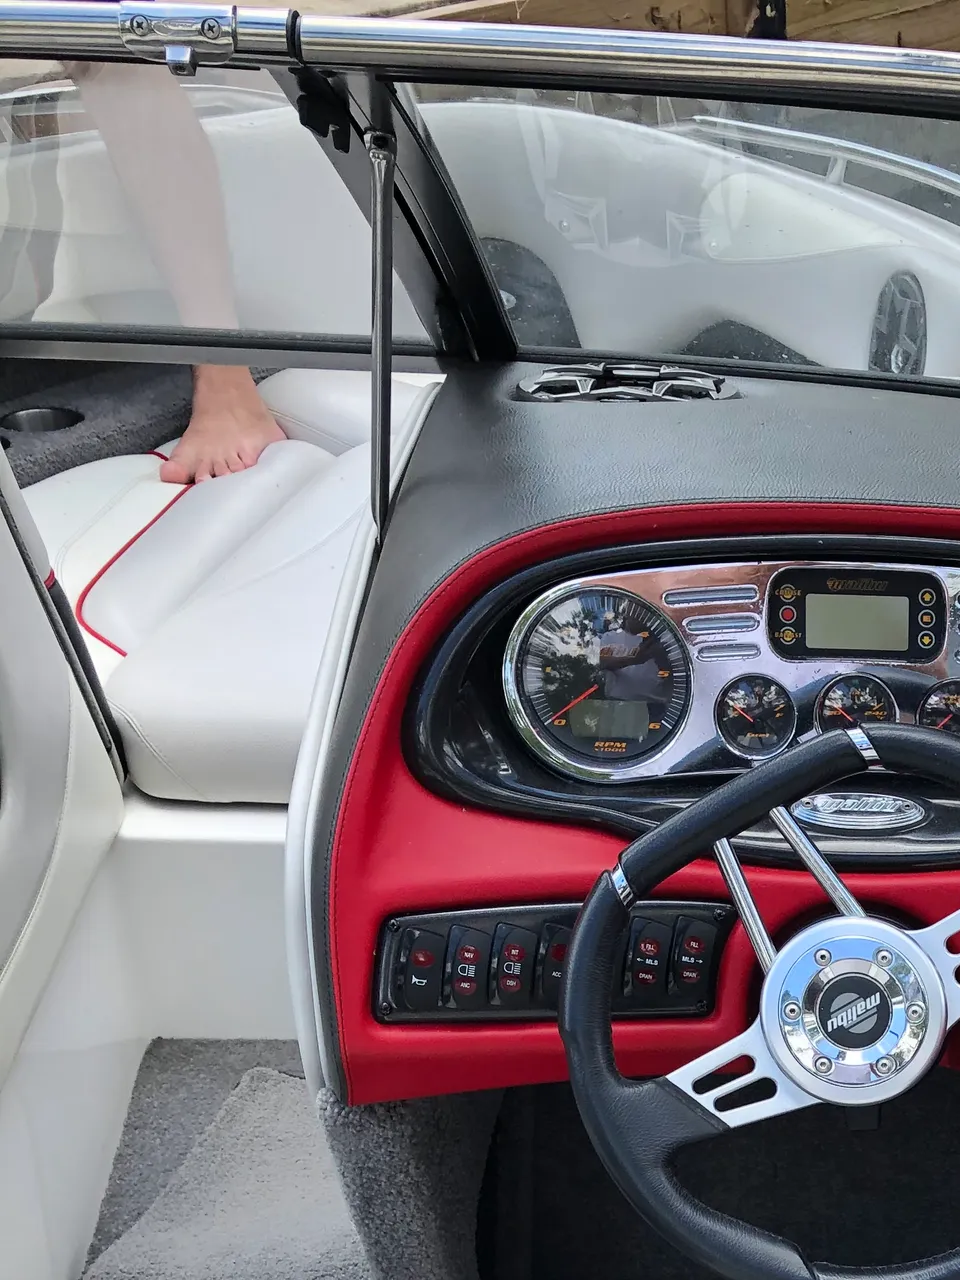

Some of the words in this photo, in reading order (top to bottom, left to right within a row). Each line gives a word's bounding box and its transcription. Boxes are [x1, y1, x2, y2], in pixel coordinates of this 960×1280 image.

[657, 670, 670, 678] 5
[648, 722, 661, 730] 6
[645, 958, 658, 966] MLS
[682, 955, 695, 963] MLS
[638, 972, 653, 980] DRAIN
[826, 991, 881, 1033] malibu
